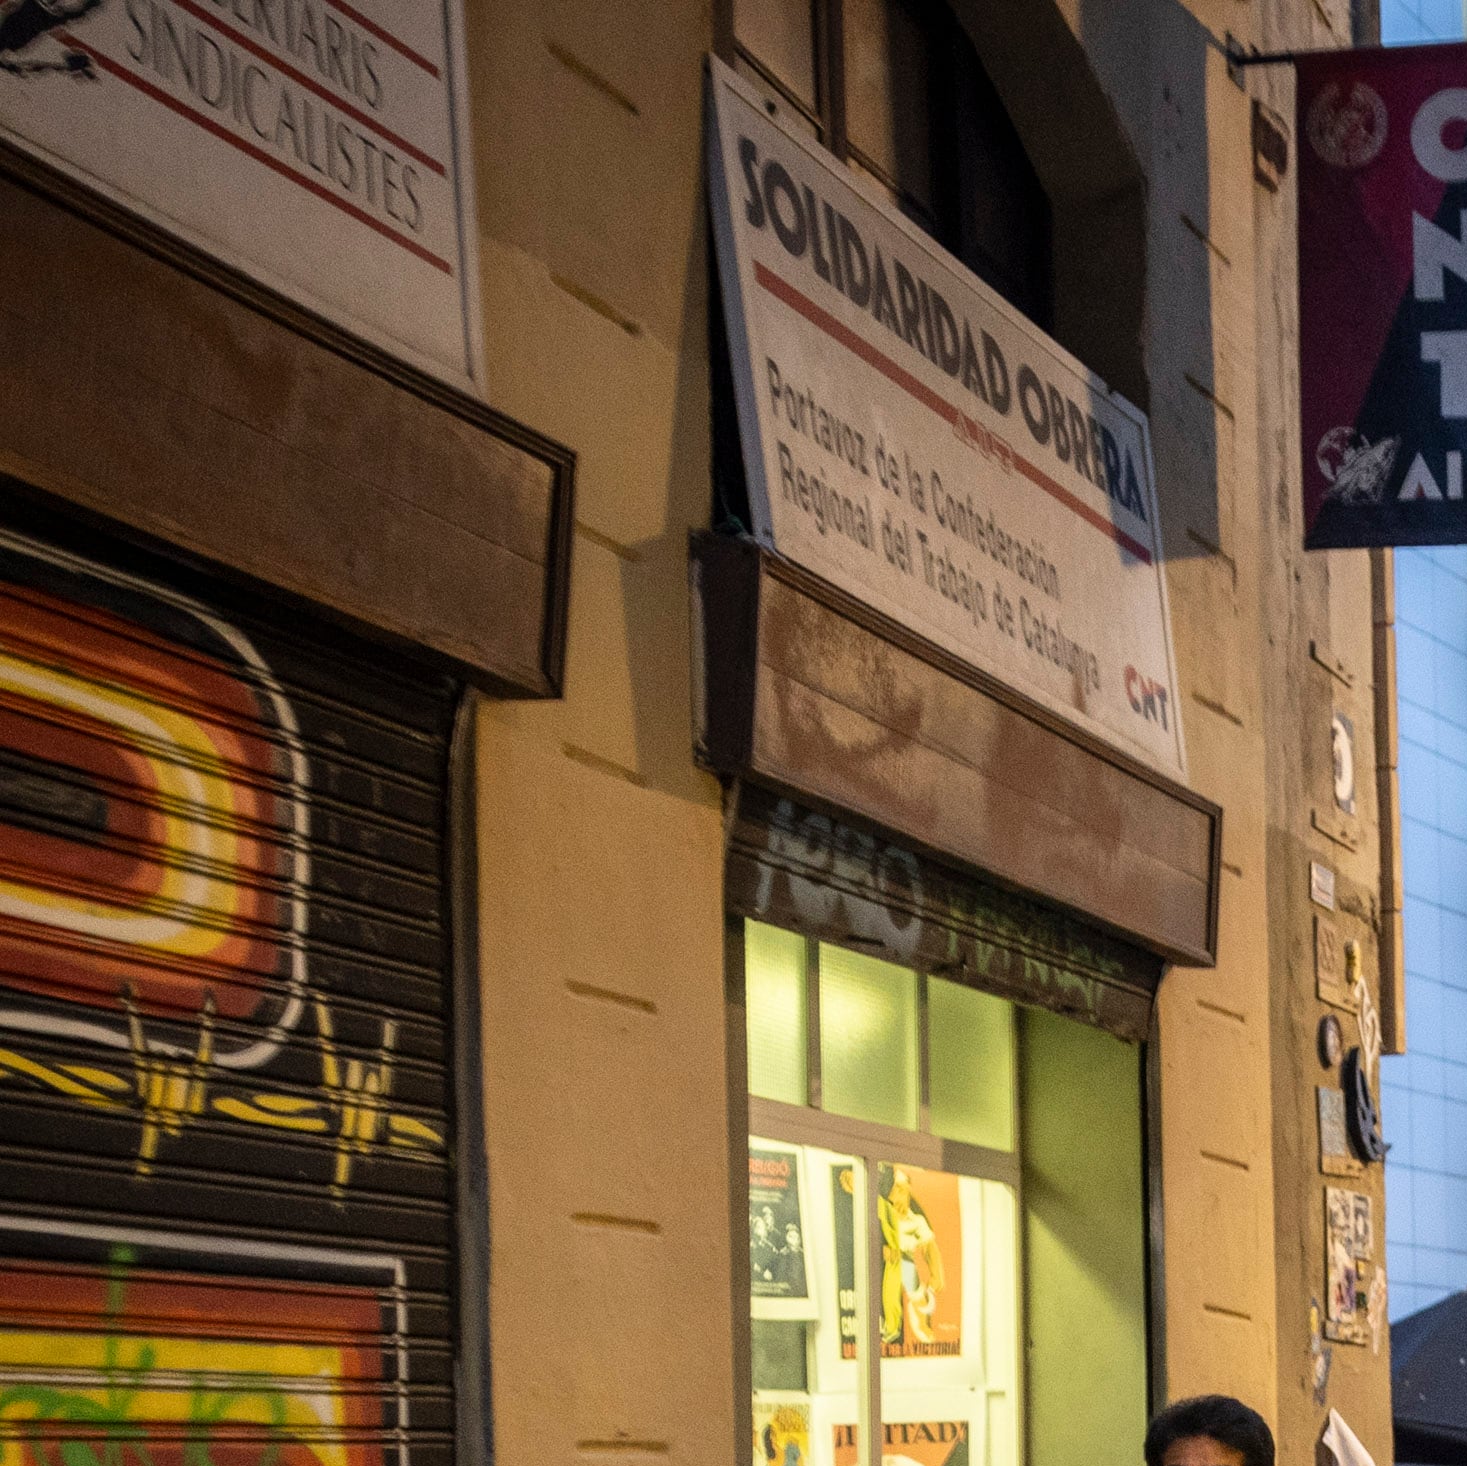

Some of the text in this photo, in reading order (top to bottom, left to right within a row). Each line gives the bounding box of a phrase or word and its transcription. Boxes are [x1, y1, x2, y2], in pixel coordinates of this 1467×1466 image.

[124, 6, 423, 233] SINDICALISTES
[737, 134, 1148, 523] SOLIDARIDAD OBRERA
[766, 356, 870, 473] Portavoz
[874, 432, 902, 496] de
[906, 452, 927, 512] la
[776, 442, 875, 552] Regional
[881, 502, 913, 576] del
[916, 528, 987, 625] Trabajo
[993, 579, 1016, 636] de
[1019, 597, 1102, 694] Catalunya
[1123, 664, 1169, 732] CNT
